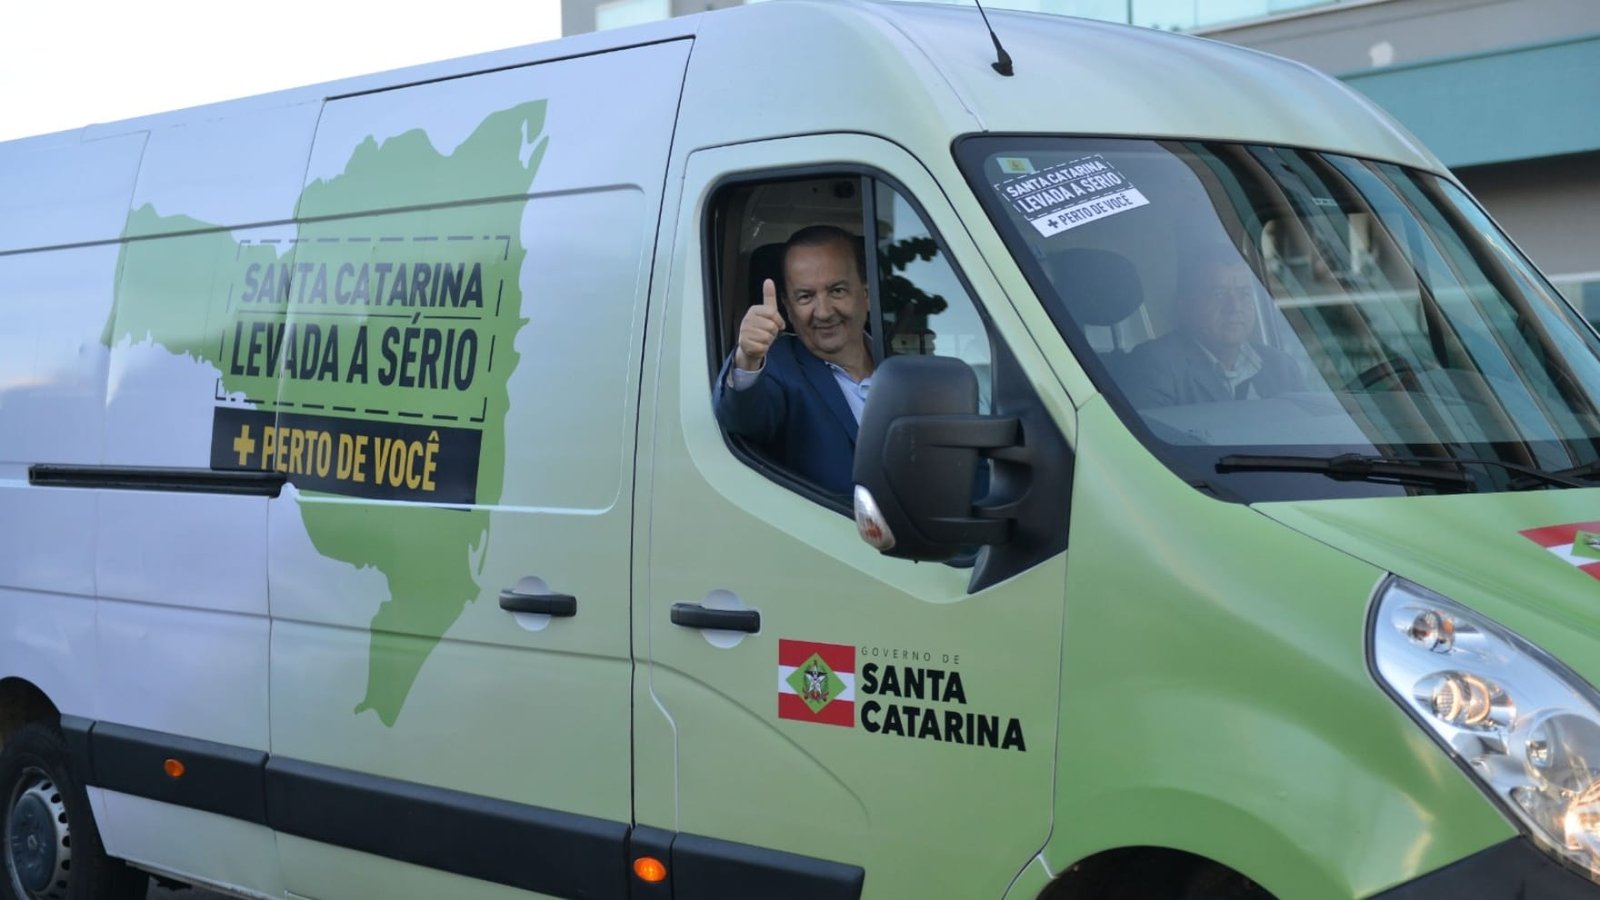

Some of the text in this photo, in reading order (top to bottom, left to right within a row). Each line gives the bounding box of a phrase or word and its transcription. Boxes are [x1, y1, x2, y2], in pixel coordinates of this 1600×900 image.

[1006, 160, 1107, 198] SANTA CATARINA
[1018, 171, 1122, 213] LEVADA A SÉRIO
[1058, 207, 1093, 226] PERTO
[1089, 202, 1107, 215] DE
[1103, 193, 1133, 210] VOCÊ
[241, 261, 484, 308] SANTA CATARINA
[230, 312, 478, 392] LEVADA A SÉRIO
[261, 426, 332, 478] PERTO
[336, 434, 368, 482] DE
[374, 431, 441, 492] VOCÊ
[861, 646, 960, 665] GOVERNO DE
[861, 662, 967, 705] SANTA
[860, 700, 1027, 752] CATARINA
